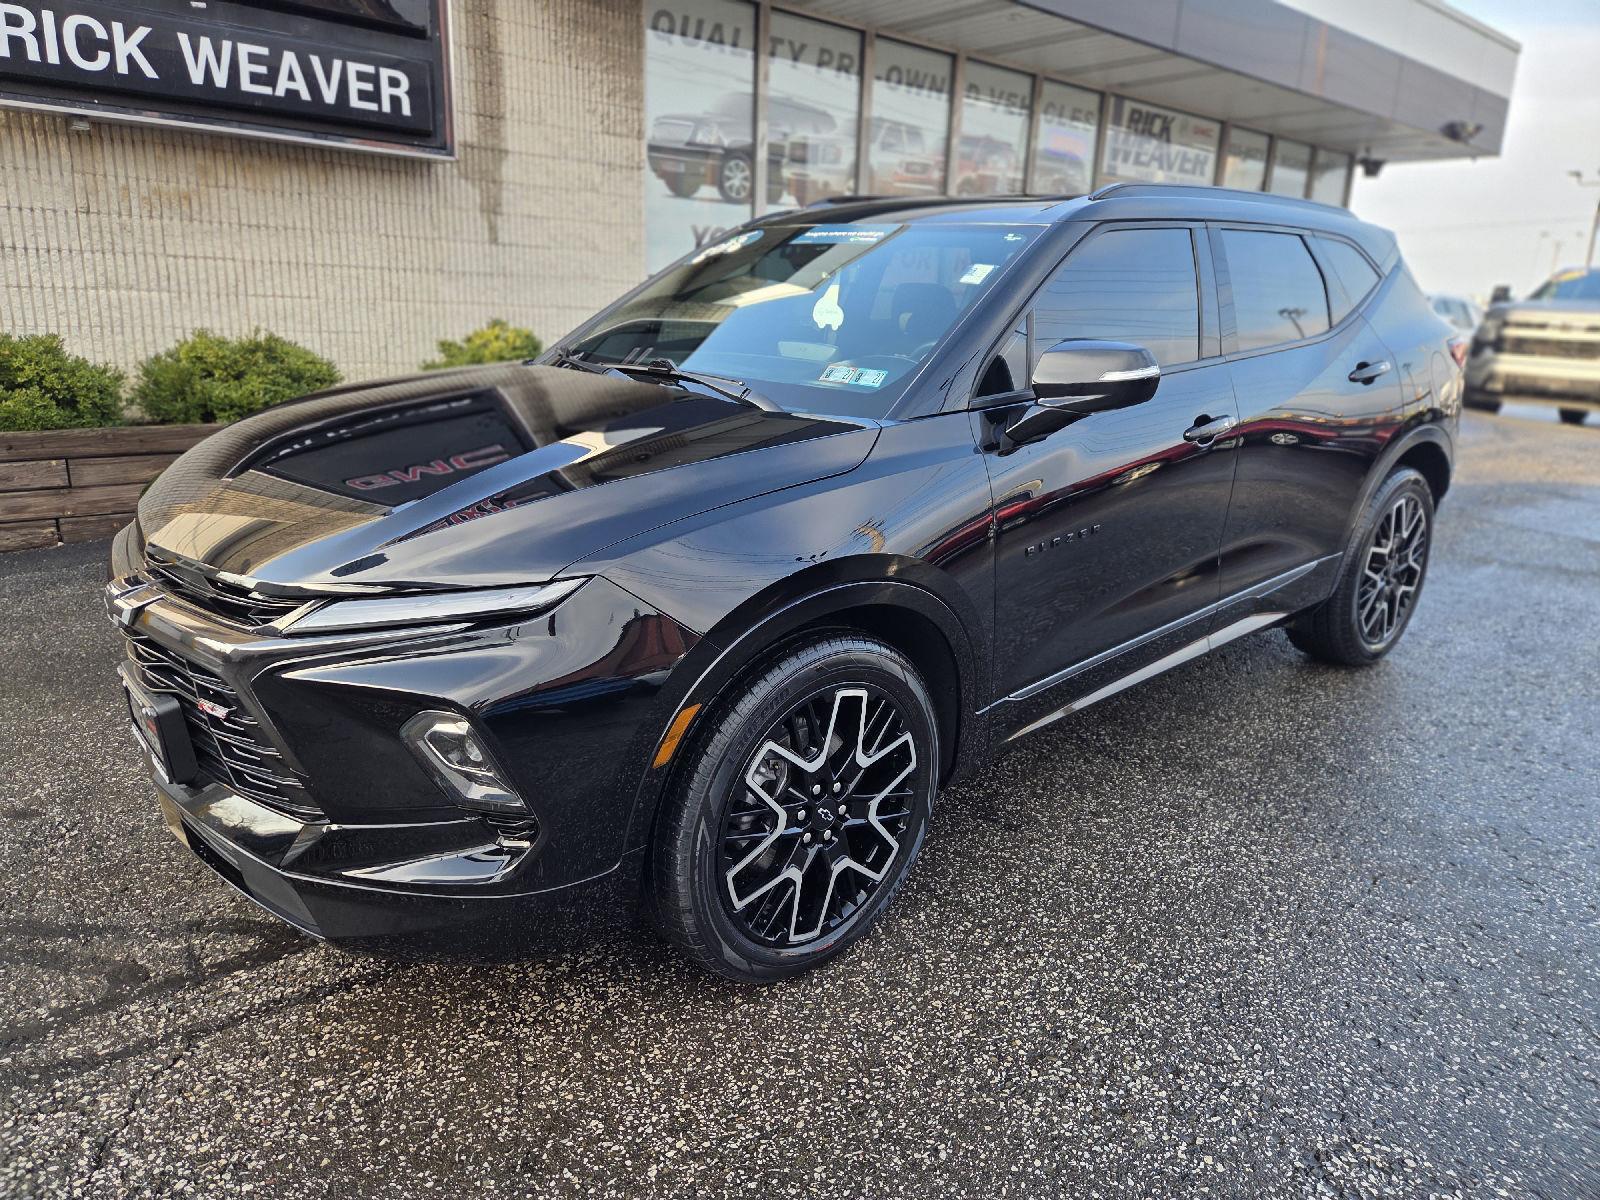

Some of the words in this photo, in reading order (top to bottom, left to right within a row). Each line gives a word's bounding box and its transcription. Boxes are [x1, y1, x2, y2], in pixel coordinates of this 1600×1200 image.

[0, 3, 159, 79] RICK
[176, 31, 412, 117] WEAVER
[651, 9, 807, 69] QUALTY
[816, 47, 980, 104] PR-OWND
[989, 87, 1096, 131] VEHCLES
[1110, 140, 1210, 177] WEAVER
[1126, 108, 1177, 143] RICK
